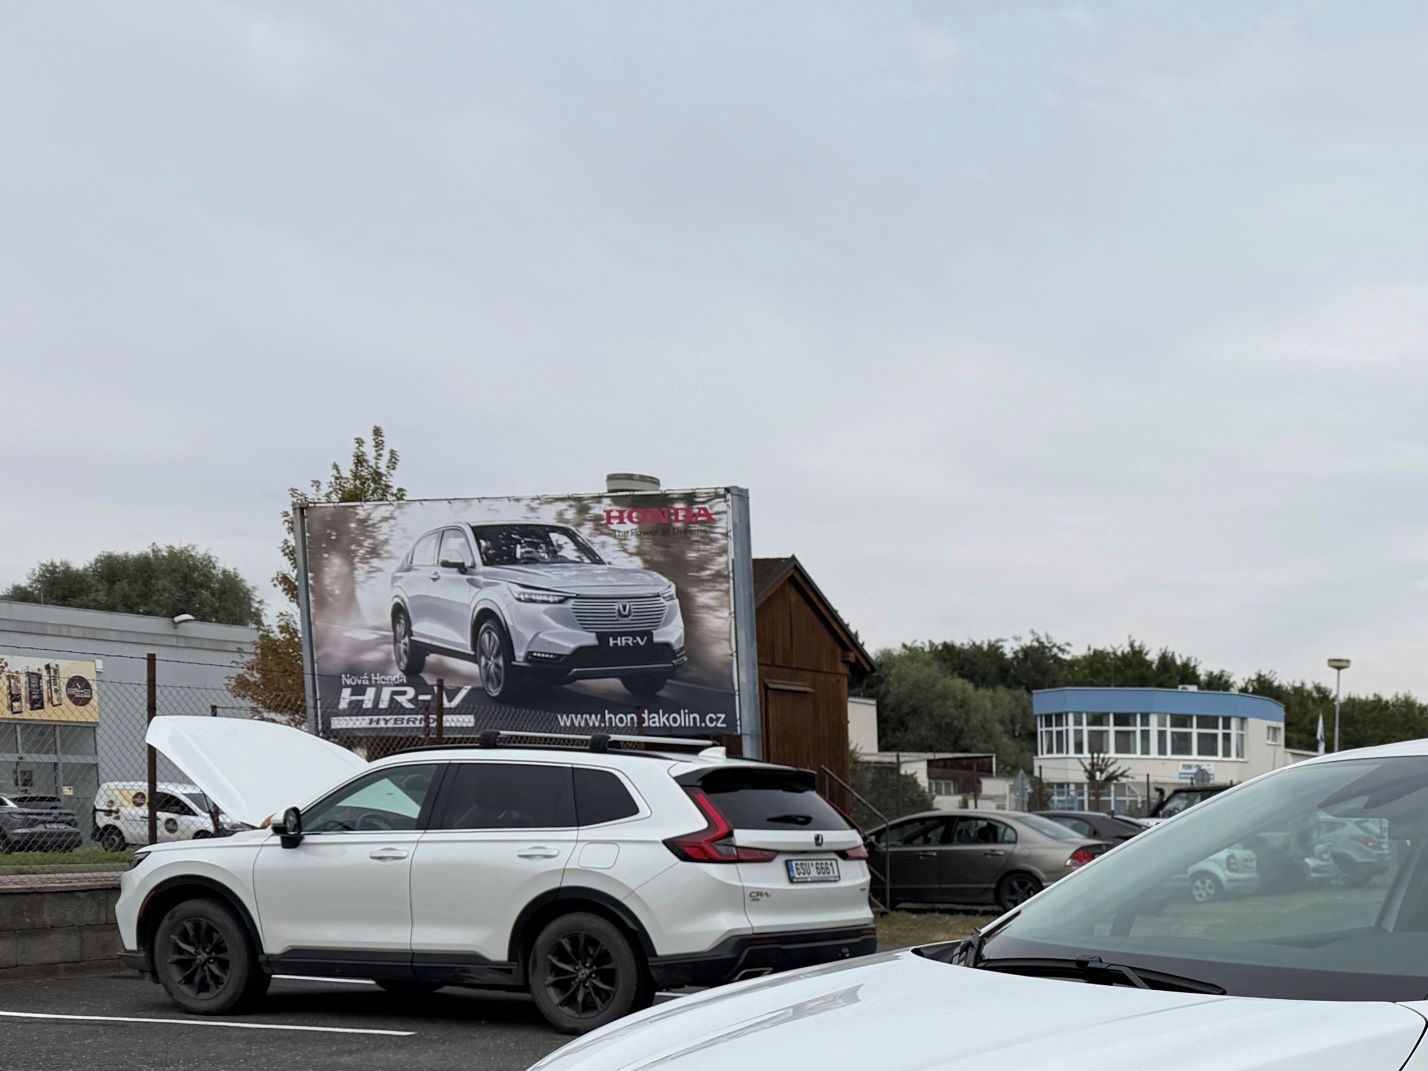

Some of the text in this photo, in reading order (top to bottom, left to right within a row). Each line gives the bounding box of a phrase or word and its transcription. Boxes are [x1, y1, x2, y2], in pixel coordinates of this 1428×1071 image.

[603, 506, 716, 526] HONDA
[341, 672, 407, 686] Nová Honda
[338, 686, 472, 710] HR-V
[369, 716, 438, 726] HYBRID
